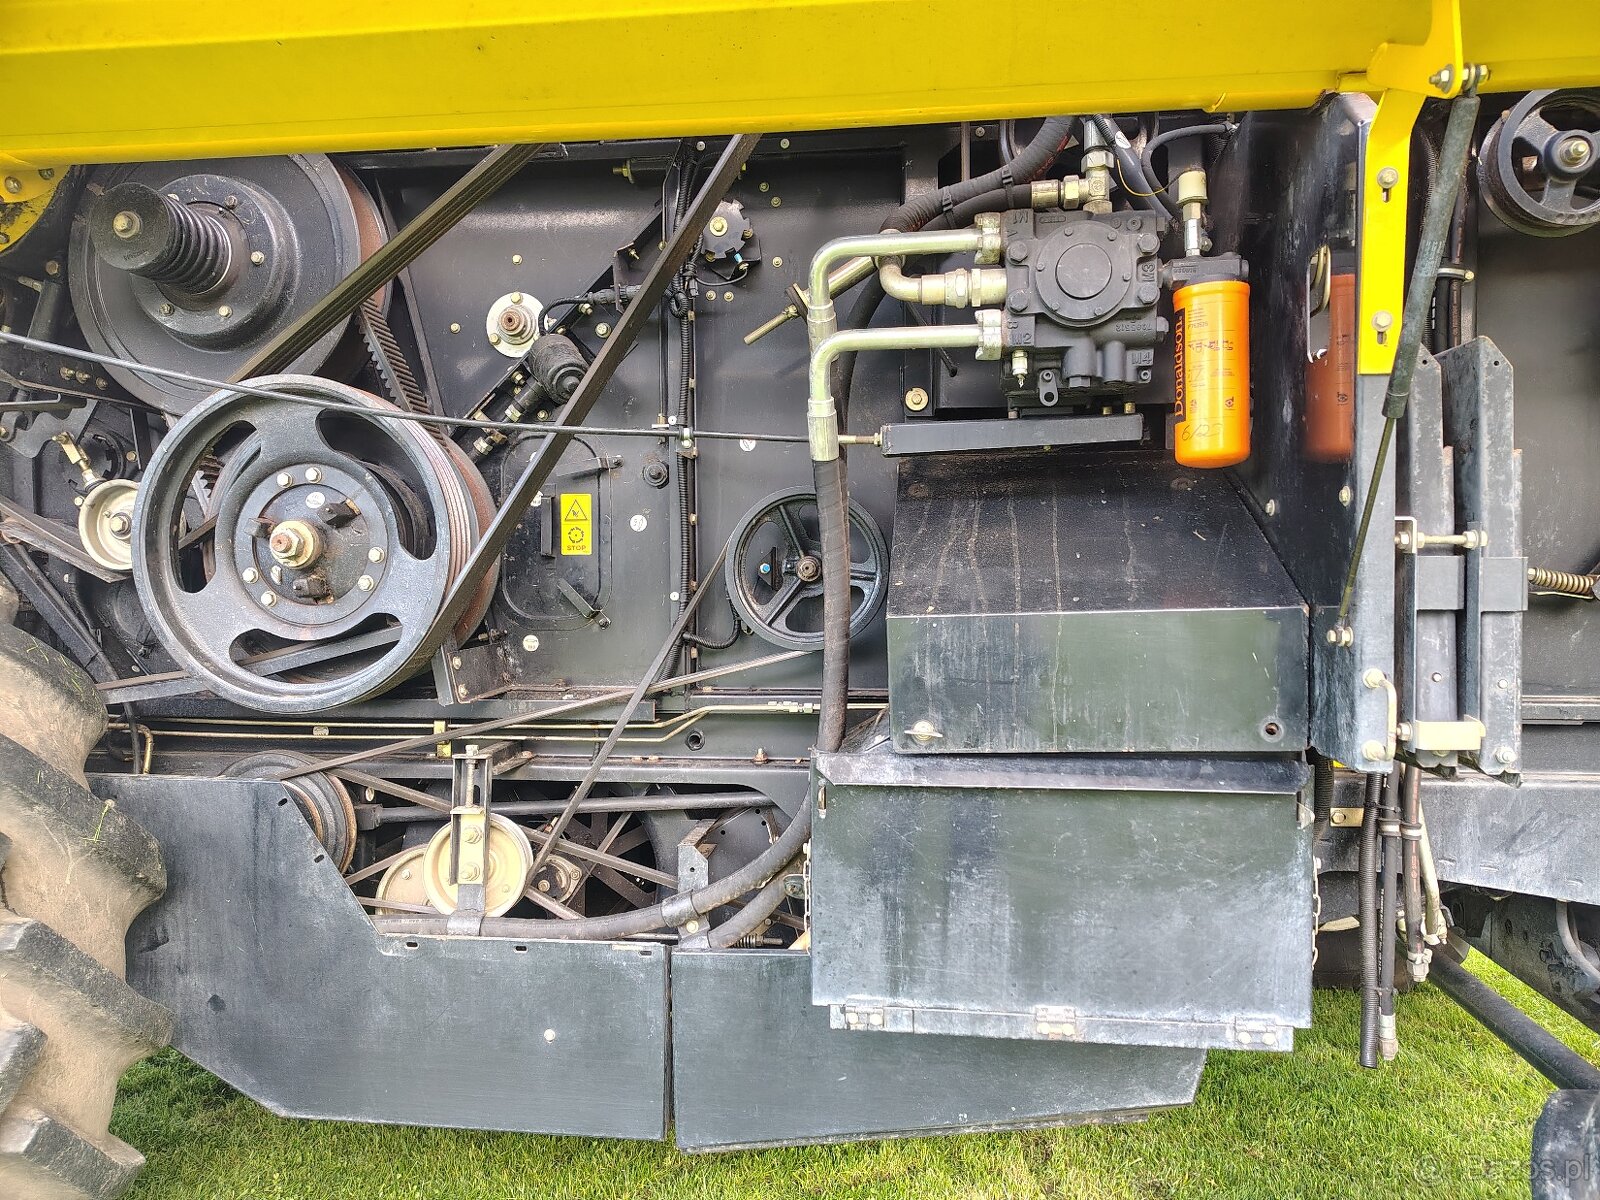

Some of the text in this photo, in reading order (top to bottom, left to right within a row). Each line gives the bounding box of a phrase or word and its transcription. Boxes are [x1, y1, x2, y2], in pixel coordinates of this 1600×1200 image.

[1143, 263, 1157, 284] M3
[1011, 332, 1033, 345] M2
[1131, 352, 1153, 365] M4
